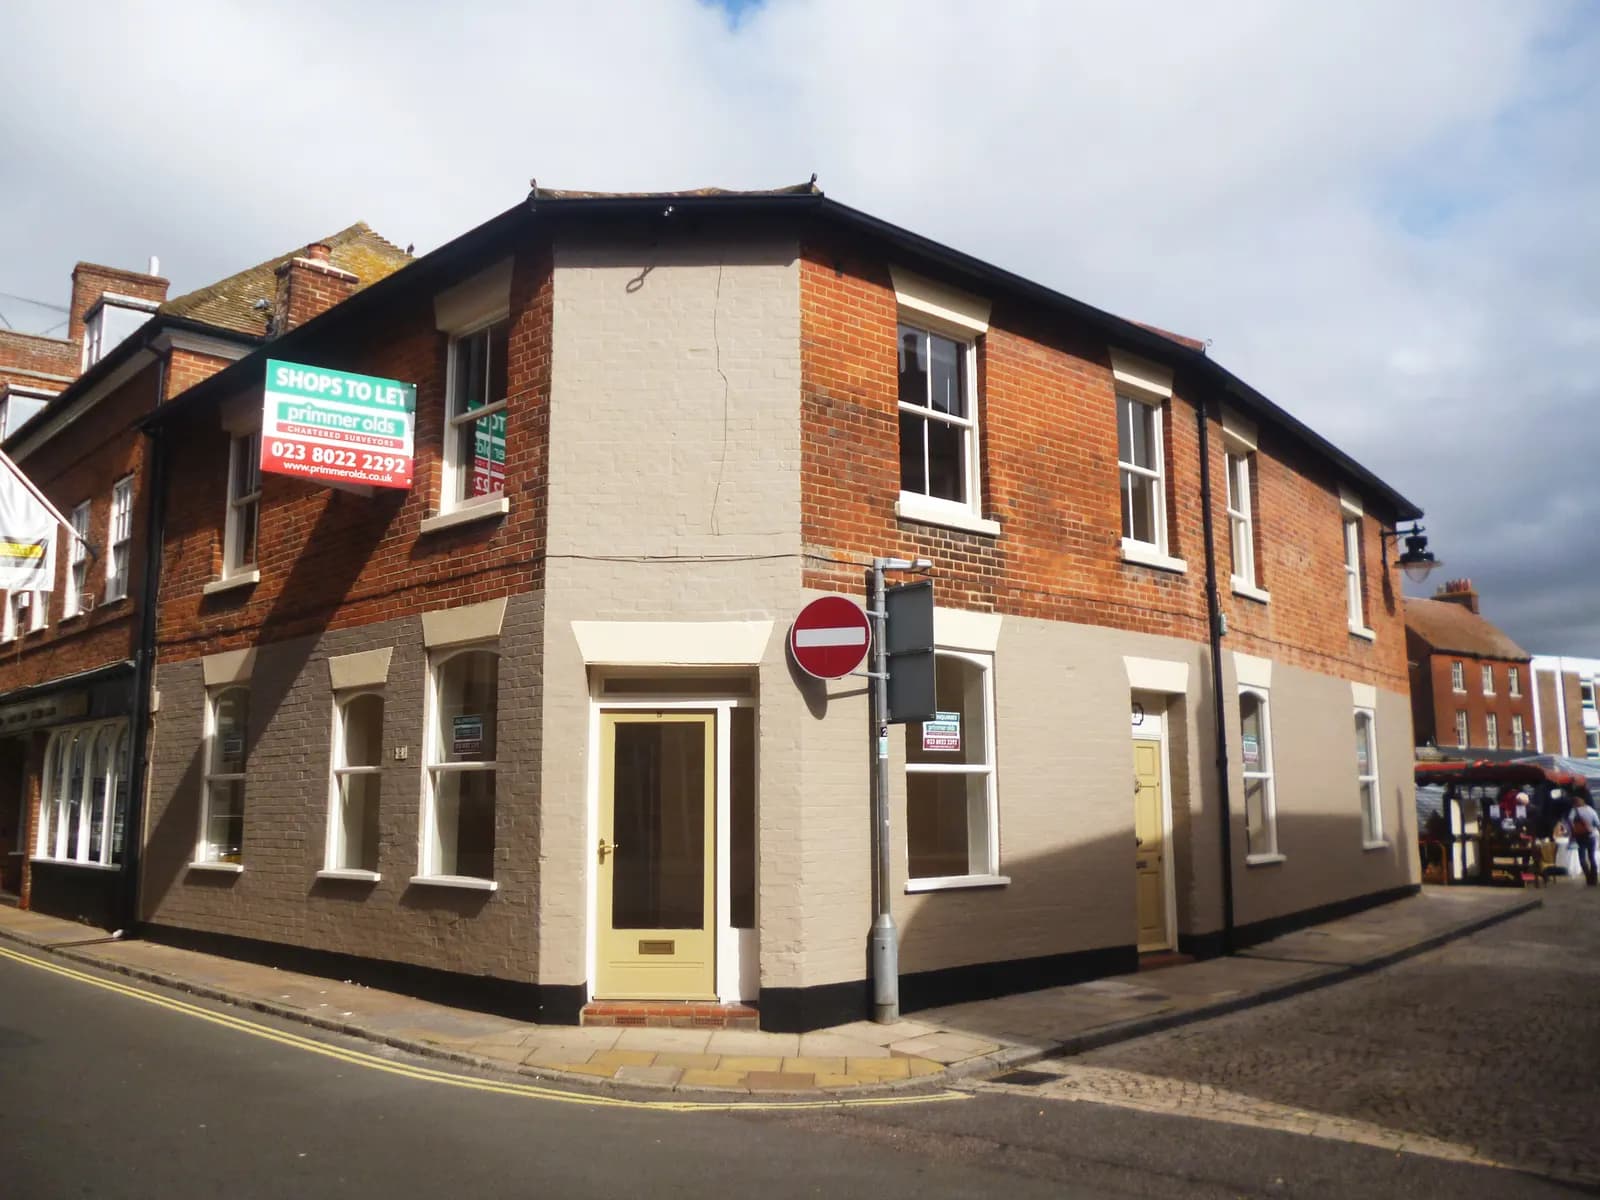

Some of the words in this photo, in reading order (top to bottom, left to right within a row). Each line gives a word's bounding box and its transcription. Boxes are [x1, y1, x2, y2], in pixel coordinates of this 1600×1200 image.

[276, 367, 343, 395] SHOPS
[346, 380, 371, 400] TO
[375, 385, 408, 406] LET
[287, 404, 361, 430] primmer
[362, 412, 395, 433] olds
[287, 426, 340, 440] CHARTERED
[344, 434, 394, 447] SURVEYORS
[271, 441, 306, 460] 023
[312, 447, 357, 467] 8022
[362, 454, 406, 473] 2292
[283, 462, 393, 482] www.primmerolds.co.uk
